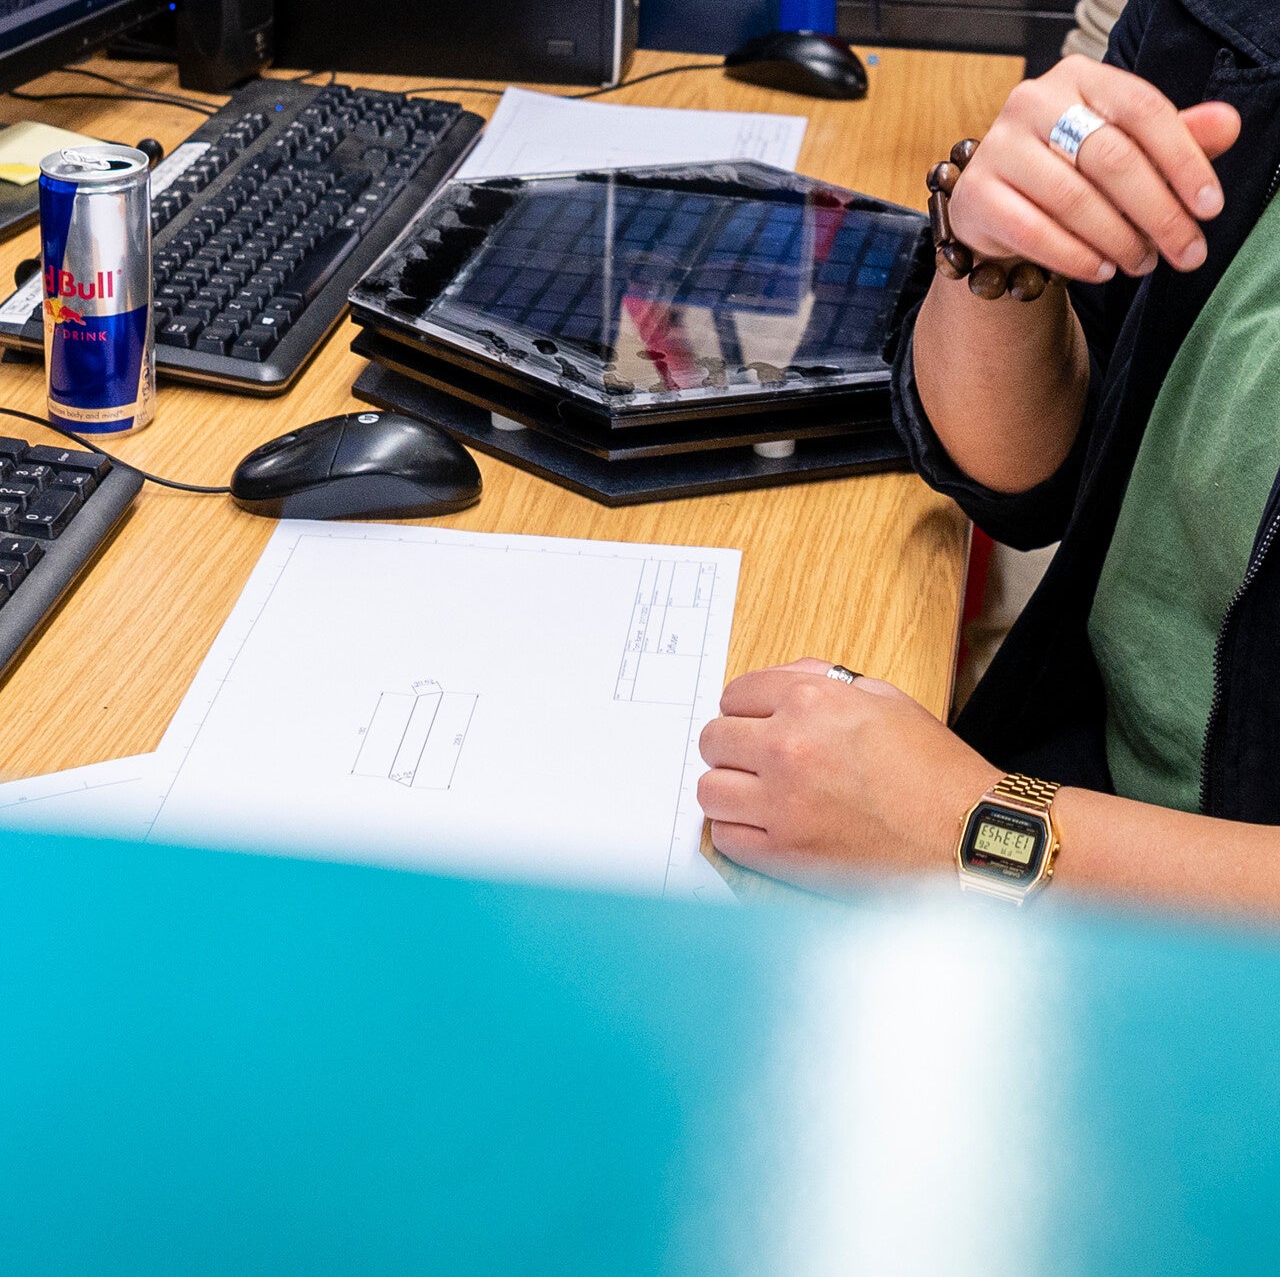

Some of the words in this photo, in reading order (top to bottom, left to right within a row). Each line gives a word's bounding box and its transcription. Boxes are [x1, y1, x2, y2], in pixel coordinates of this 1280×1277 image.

[58, 270, 113, 300] Bull
[63, 329, 108, 342] DRINK
[66, 410, 84, 420] body
[85, 411, 100, 420] and
[982, 824, 995, 838] 53
[978, 840, 990, 850] 26
